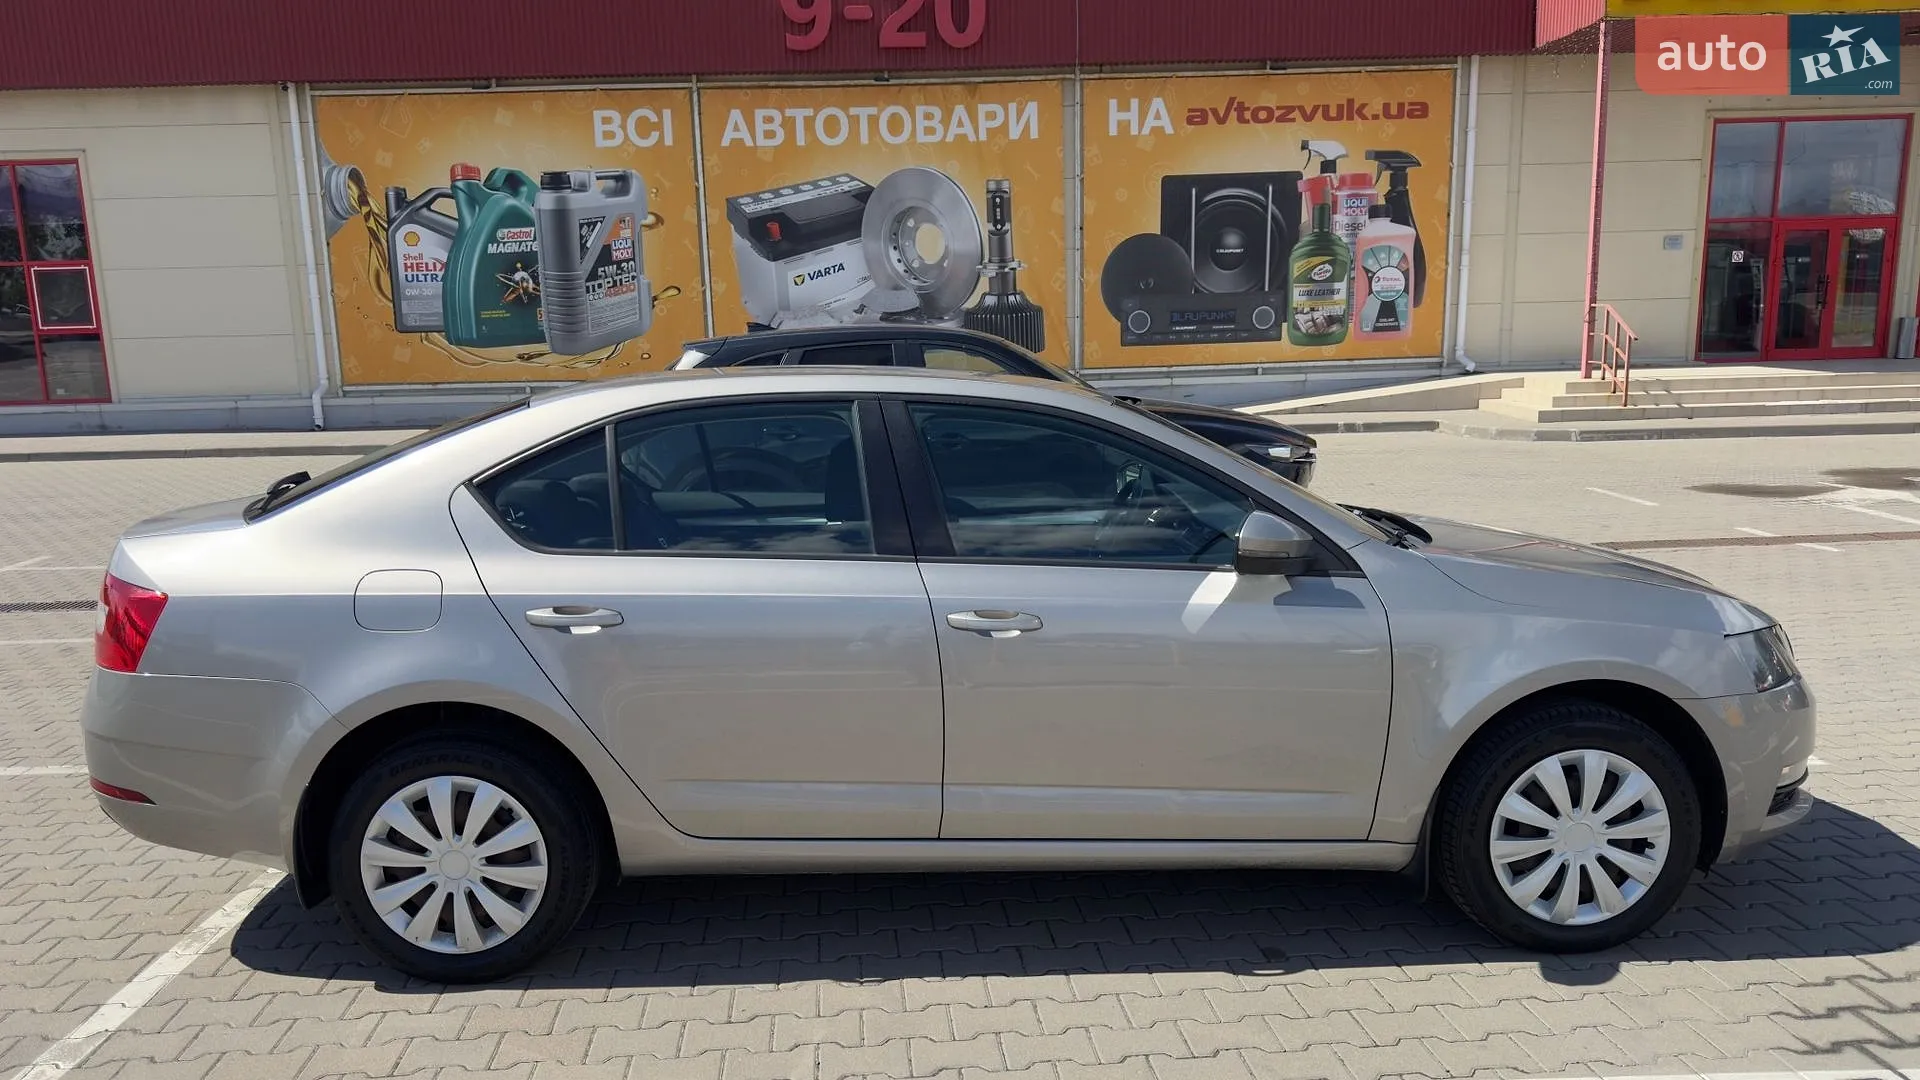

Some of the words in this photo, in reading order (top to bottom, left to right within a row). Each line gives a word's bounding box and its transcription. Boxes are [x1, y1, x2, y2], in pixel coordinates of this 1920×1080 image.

[782, 0, 986, 50] 9-20
[593, 108, 674, 148] ВСІ
[721, 101, 1040, 147] АВТОТОВАРИ
[1108, 97, 1174, 137] НА
[1186, 96, 1430, 126] avtozvuk.ua
[1335, 220, 1367, 231] Diesel
[506, 229, 533, 240] Castrol
[487, 240, 540, 254] MAGNATE
[612, 239, 633, 249] LIQUI
[403, 253, 423, 261] Shell
[612, 248, 633, 260] MOLY
[597, 261, 636, 278] 5W-30
[807, 262, 846, 281] VARTA
